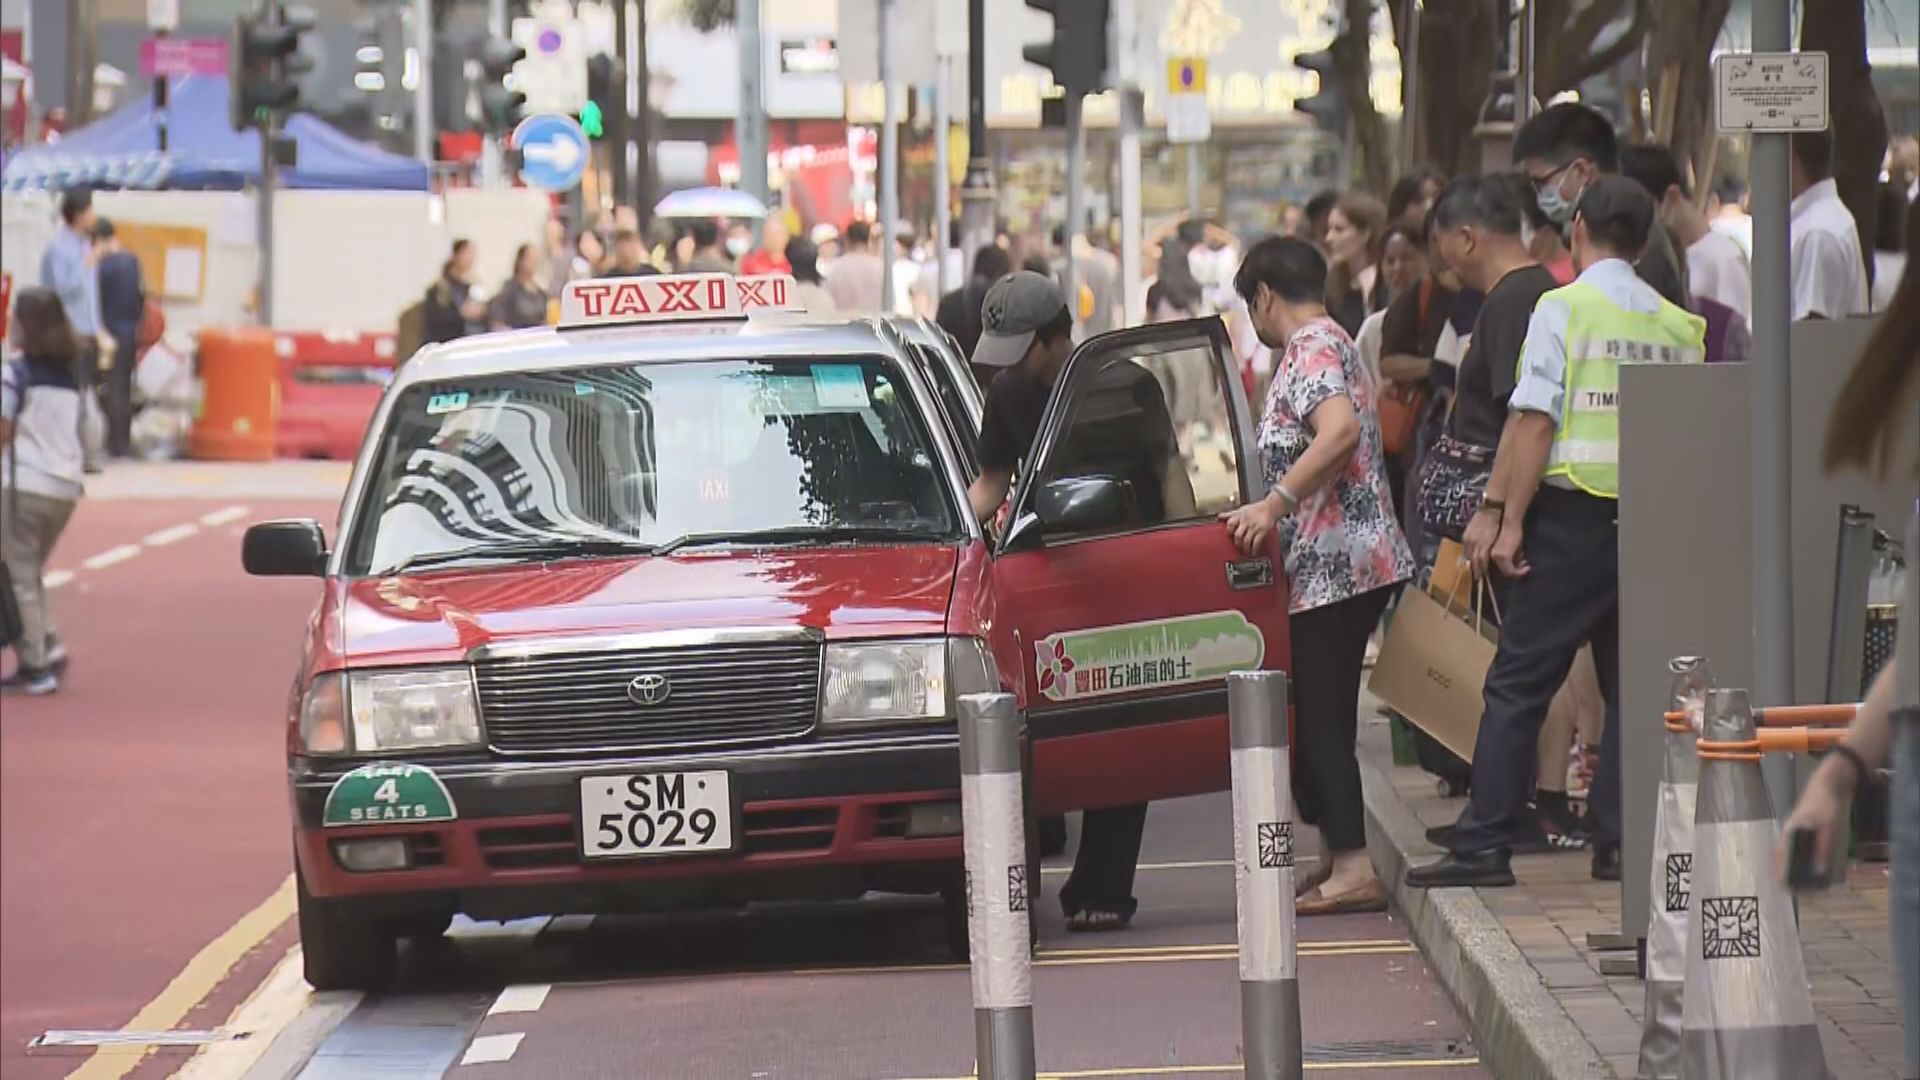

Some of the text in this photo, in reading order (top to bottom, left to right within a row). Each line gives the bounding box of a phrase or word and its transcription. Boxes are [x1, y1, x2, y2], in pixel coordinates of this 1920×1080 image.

[574, 279, 727, 317] TAXI
[737, 279, 787, 307] XI
[1074, 656, 1193, 693] 豐田石油氣的士
[373, 778, 400, 804] 4
[623, 773, 686, 812] SM
[350, 803, 428, 820] SEATS
[596, 807, 718, 850] 5029
